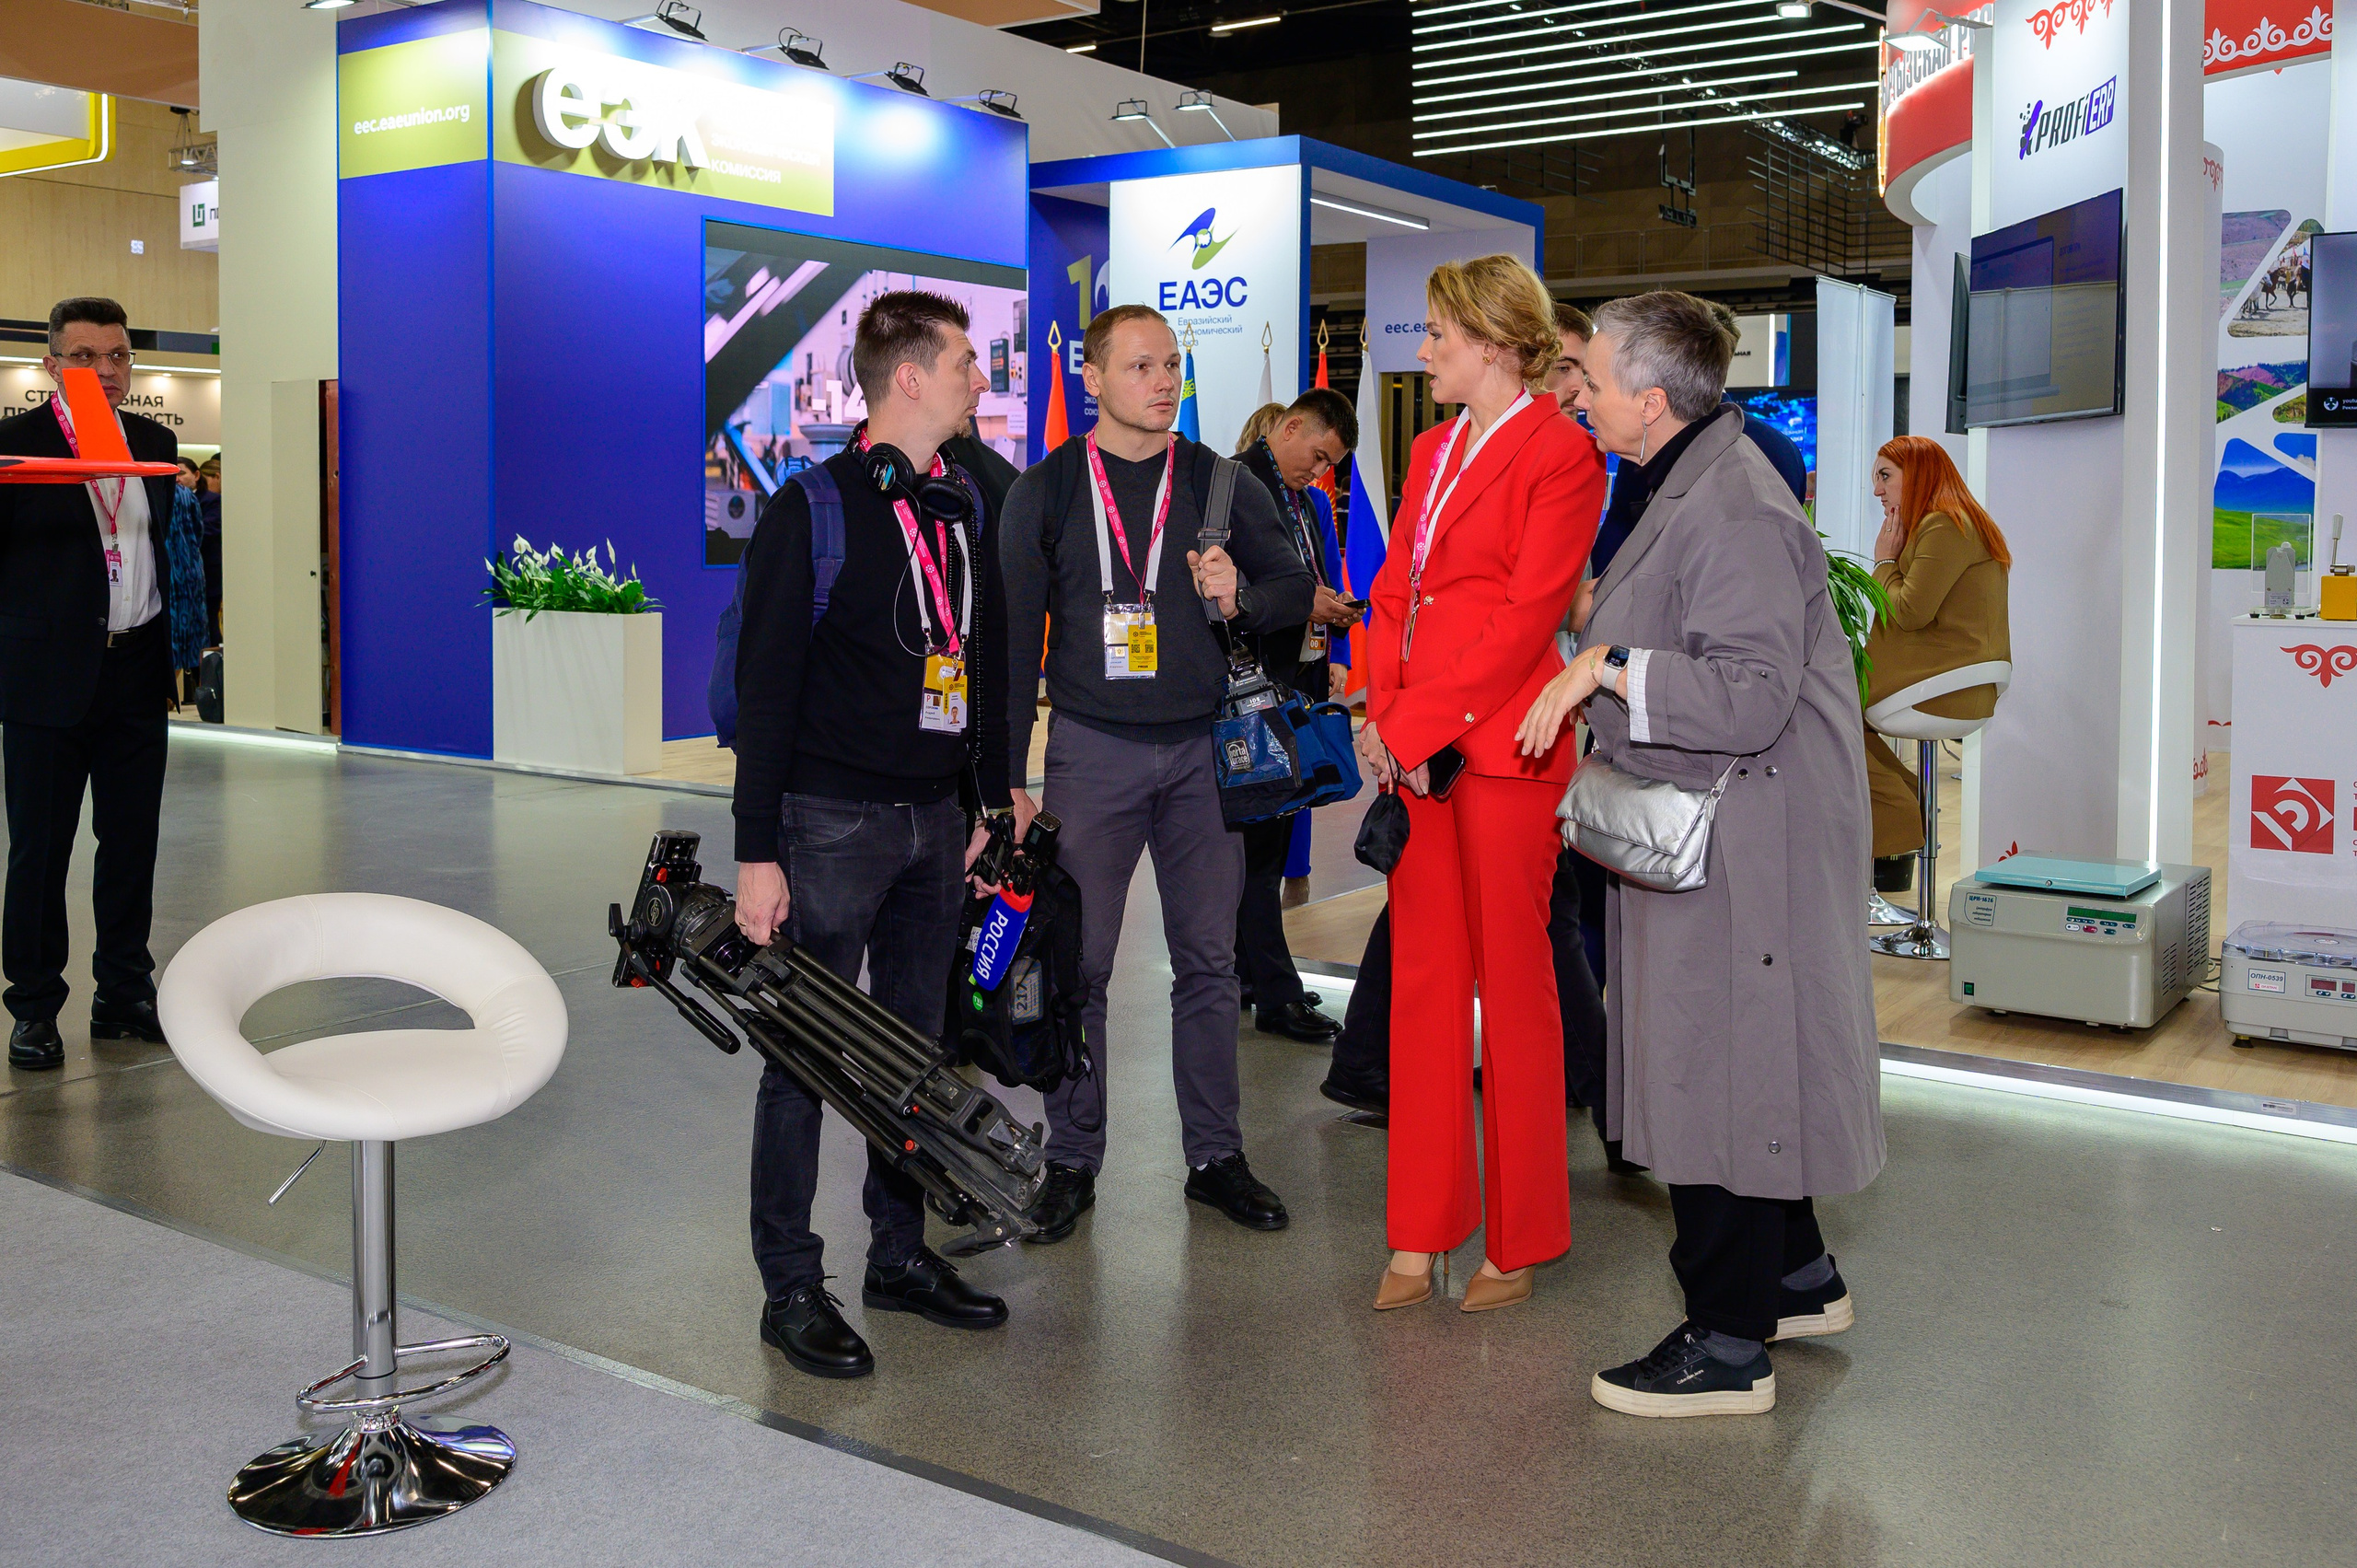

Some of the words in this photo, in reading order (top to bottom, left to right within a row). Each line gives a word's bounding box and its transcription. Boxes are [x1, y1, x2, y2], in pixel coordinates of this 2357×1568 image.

[354, 104, 470, 135] eec.eaeunion.org
[711, 158, 781, 184] КОМИССИЯ
[1159, 276, 1248, 311] ЕАЭС
[1178, 314, 1233, 326] Евразийский
[1178, 325, 1243, 337] экономический
[976, 909, 1010, 981] РОССИЯ
